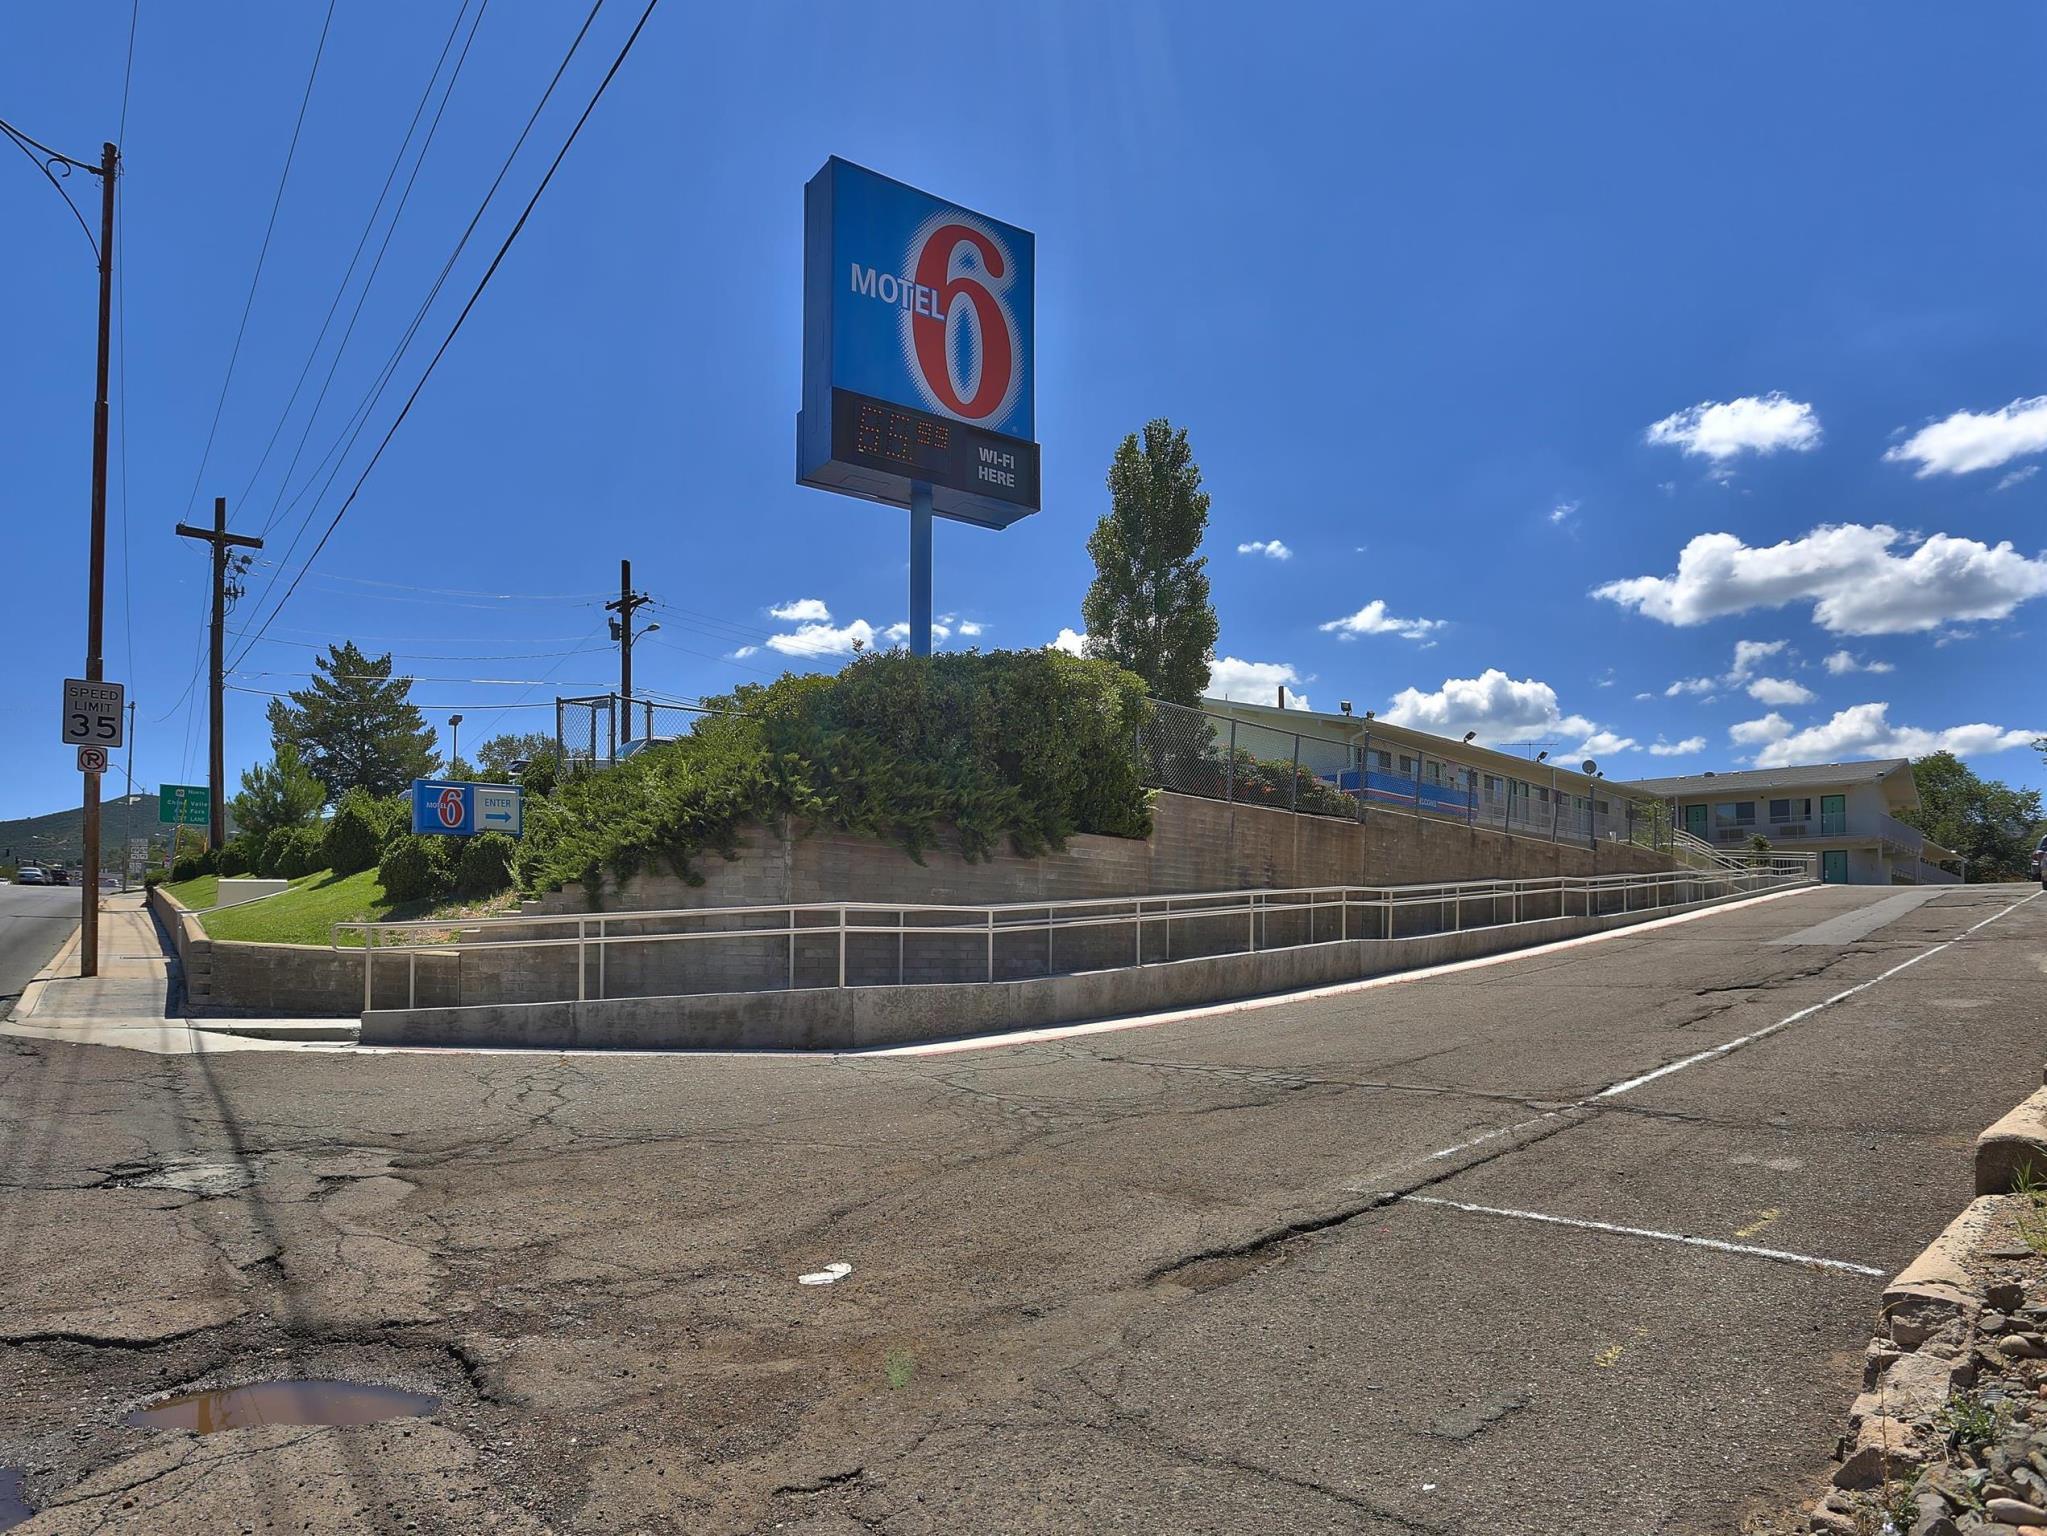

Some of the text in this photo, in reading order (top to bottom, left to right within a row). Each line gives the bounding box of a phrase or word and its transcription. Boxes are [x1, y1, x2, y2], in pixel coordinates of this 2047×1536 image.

[851, 219, 1016, 425] MOTEL 6
[978, 446, 1015, 470] WI-FI
[978, 465, 1015, 488] HERE
[69, 686, 119, 701] SPEED
[74, 700, 113, 713] LIMIT
[69, 713, 117, 739] 35
[438, 788, 464, 828] 6
[484, 798, 511, 808] ENTER
